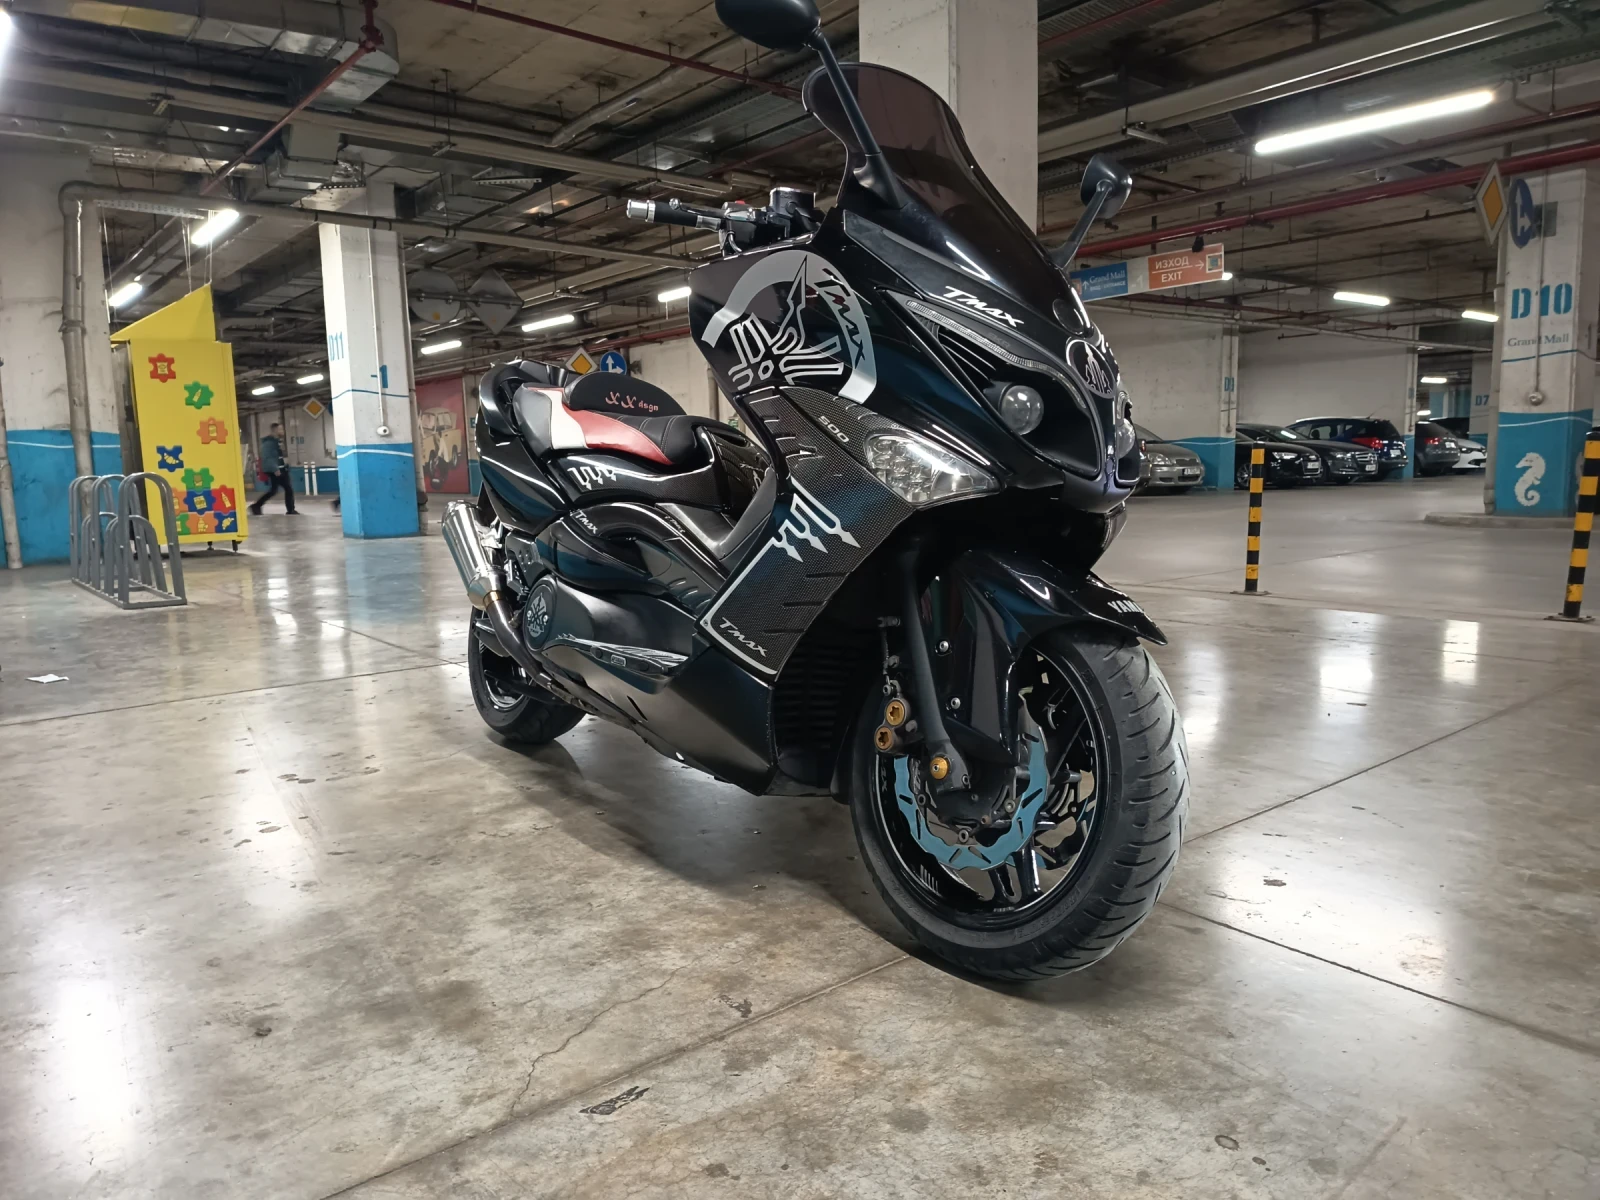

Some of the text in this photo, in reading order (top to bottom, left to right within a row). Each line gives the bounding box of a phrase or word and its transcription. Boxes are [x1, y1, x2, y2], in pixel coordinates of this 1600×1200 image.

[1155, 256, 1190, 270] ИЗХОД
[1089, 270, 1126, 284] Grand Mall
[1161, 271, 1182, 283] EXIT
[328, 331, 344, 361] D11
[1544, 333, 1569, 345] Mall
[370, 364, 388, 389] -1
[1475, 394, 1490, 406] D7
[818, 415, 850, 443] 500
